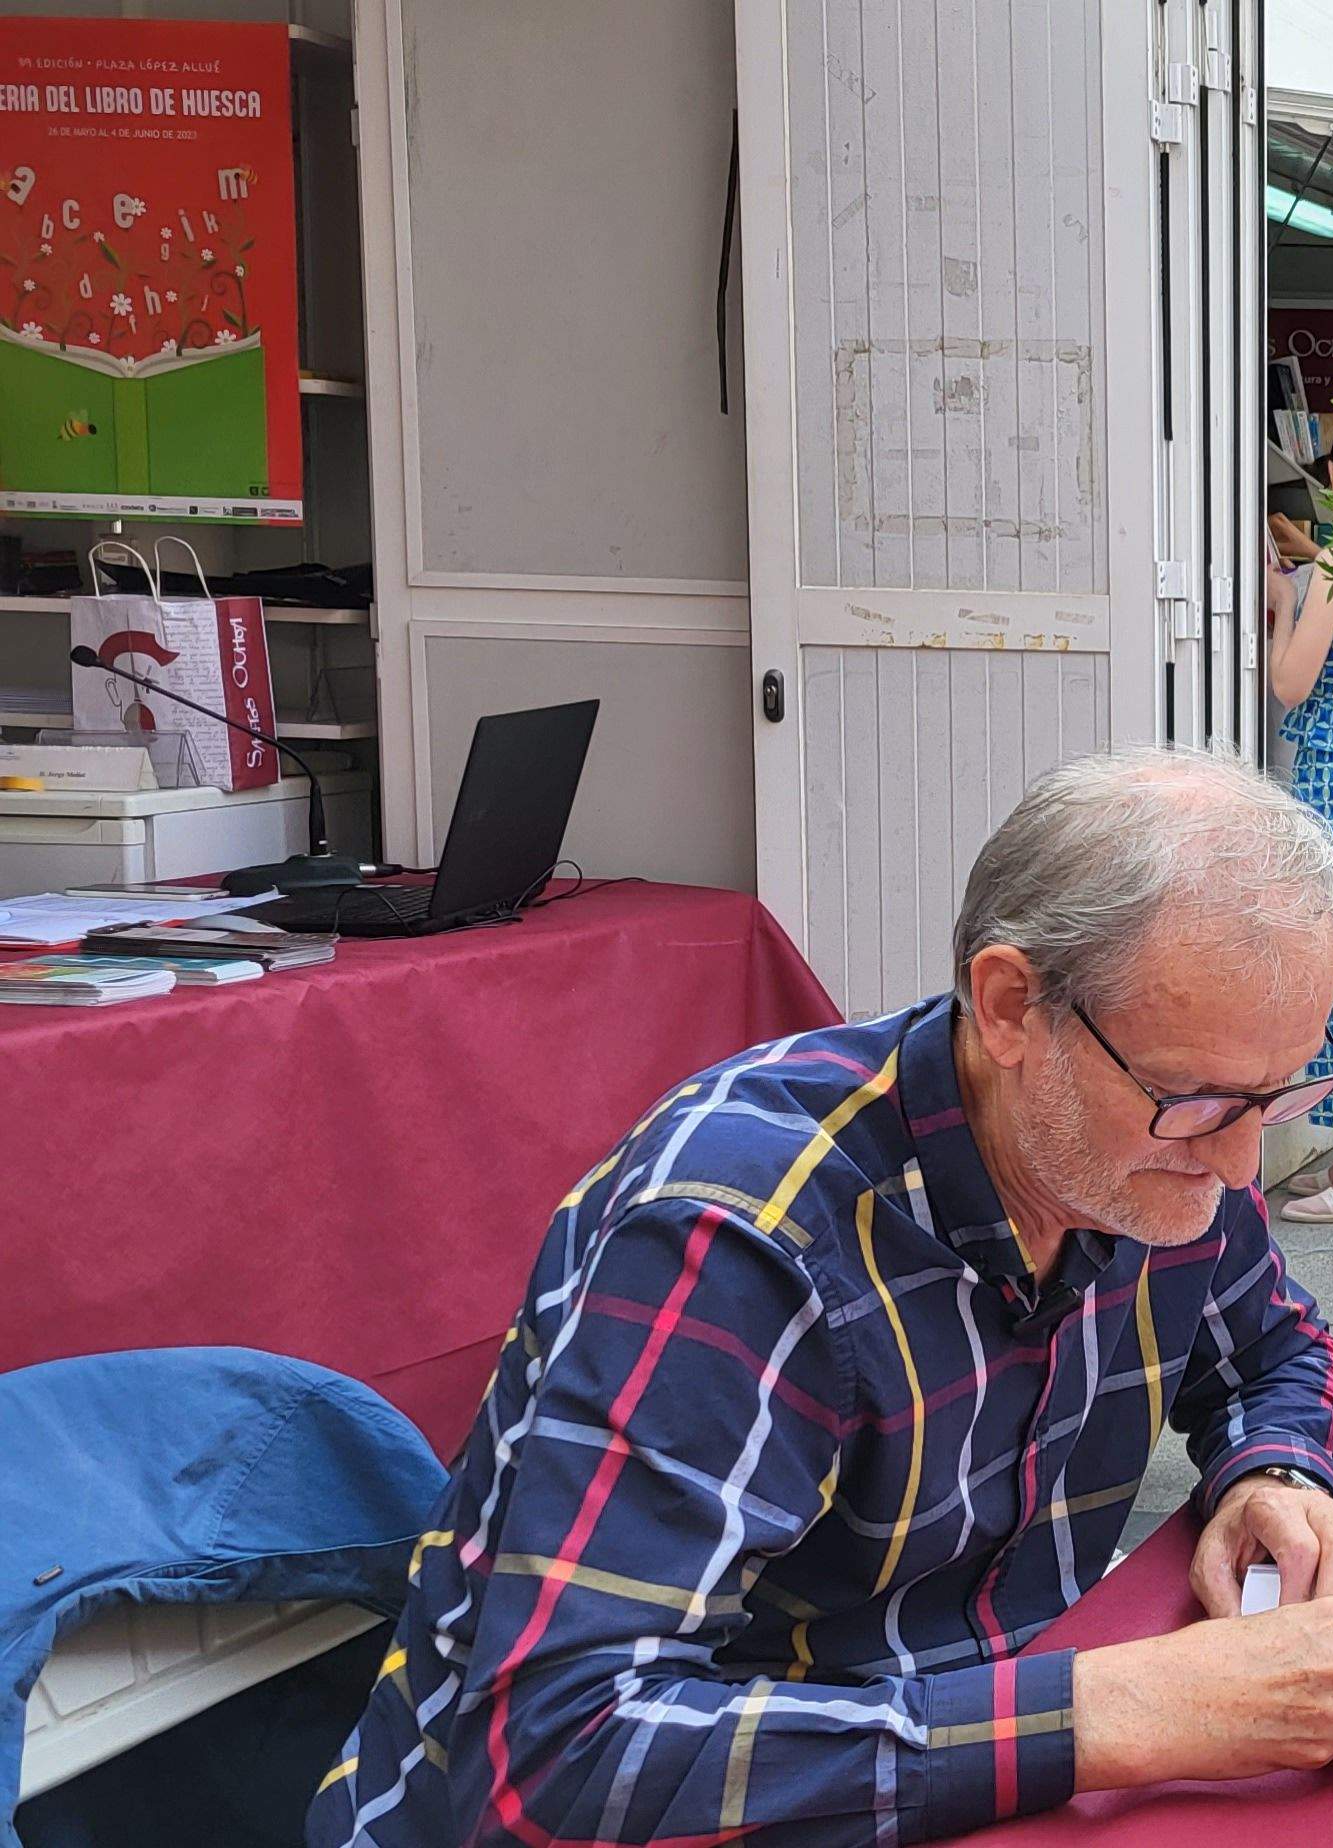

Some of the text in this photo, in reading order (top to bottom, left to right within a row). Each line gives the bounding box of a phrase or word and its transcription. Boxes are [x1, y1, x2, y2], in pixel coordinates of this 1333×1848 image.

[96, 60, 135, 71] PLAZA
[140, 58, 179, 72] LÓPEZ
[183, 59, 221, 74] ALLUÉ
[0, 84, 261, 118] ERIA DEL LIBRO DE HUESCA
[60, 127, 72, 137] DE
[73, 128, 97, 137] MAYO
[98, 128, 109, 137] AL
[110, 128, 117, 138] 4
[118, 128, 131, 138] DE
[133, 129, 160, 139] JUNIO
[162, 130, 174, 140] DE
[7, 166, 35, 205] a
[218, 168, 249, 199] m
[63, 200, 80, 229] c
[113, 193, 134, 228] e
[42, 214, 54, 239] b
[79, 273, 92, 298] d
[144, 286, 162, 315] h
[1324, 376, 1330, 386] y
